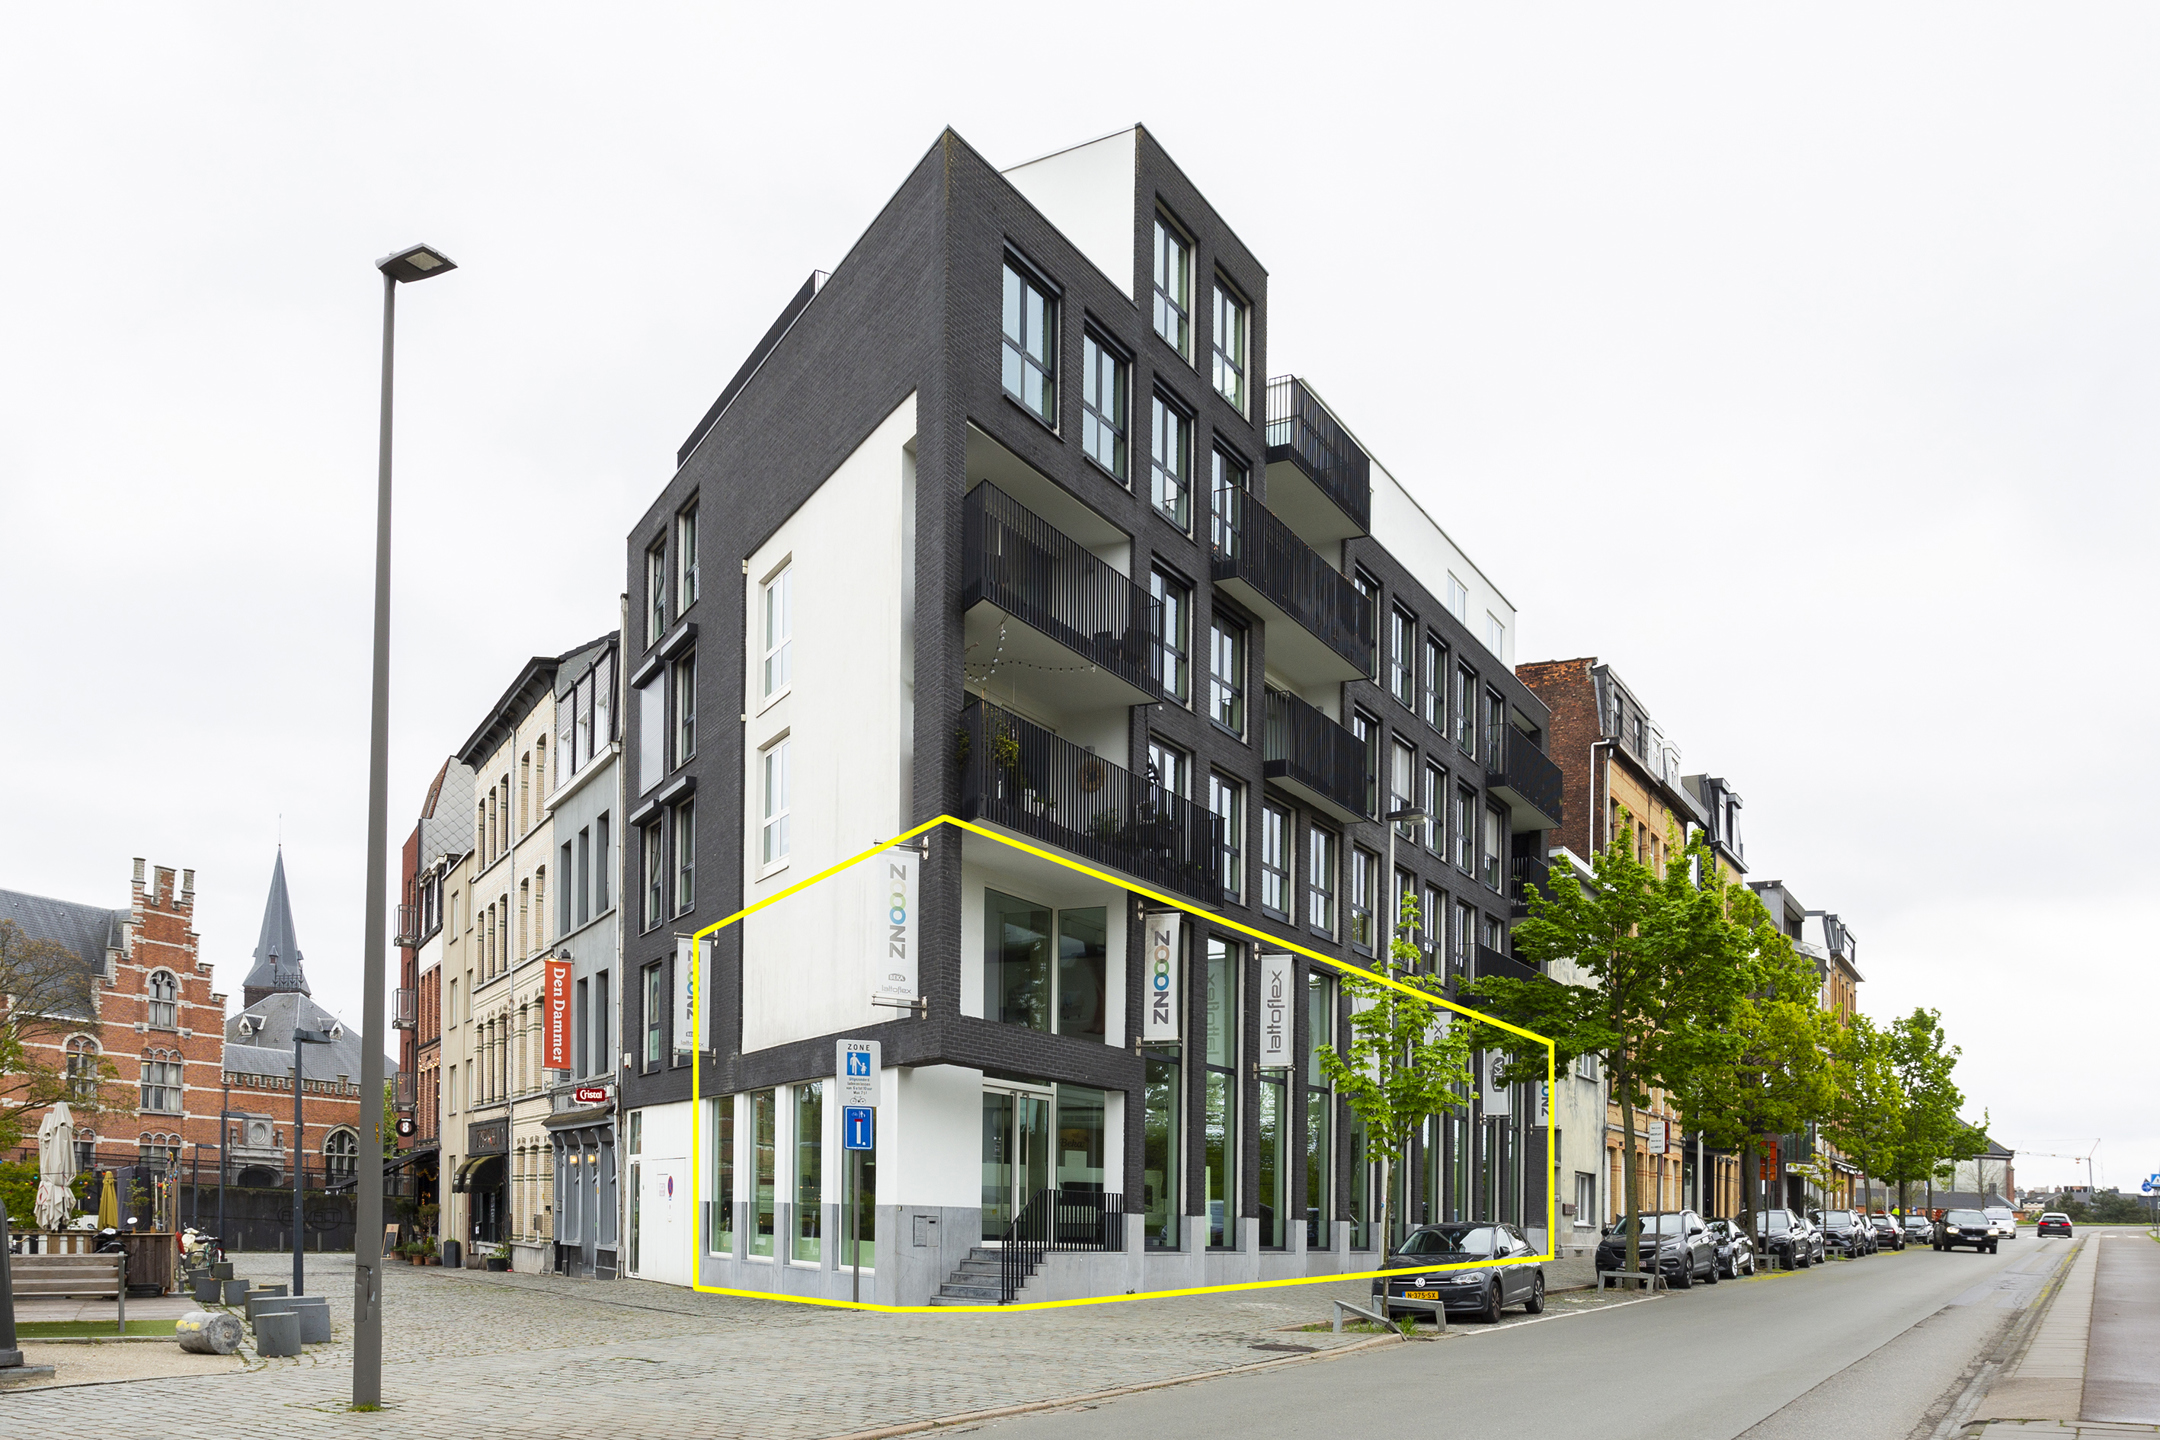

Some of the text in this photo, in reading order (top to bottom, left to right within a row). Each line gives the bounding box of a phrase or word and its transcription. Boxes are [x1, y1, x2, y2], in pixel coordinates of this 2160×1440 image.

[889, 863, 907, 960] ZOOONZ
[553, 967, 566, 1063] Den Dammer
[1153, 930, 1170, 1025] ZOOONZ
[1266, 970, 1285, 1053] lattoflex
[847, 1043, 870, 1051] ZONE
[579, 1089, 603, 1100] Cristal
[1060, 1139, 1084, 1148] Beka
